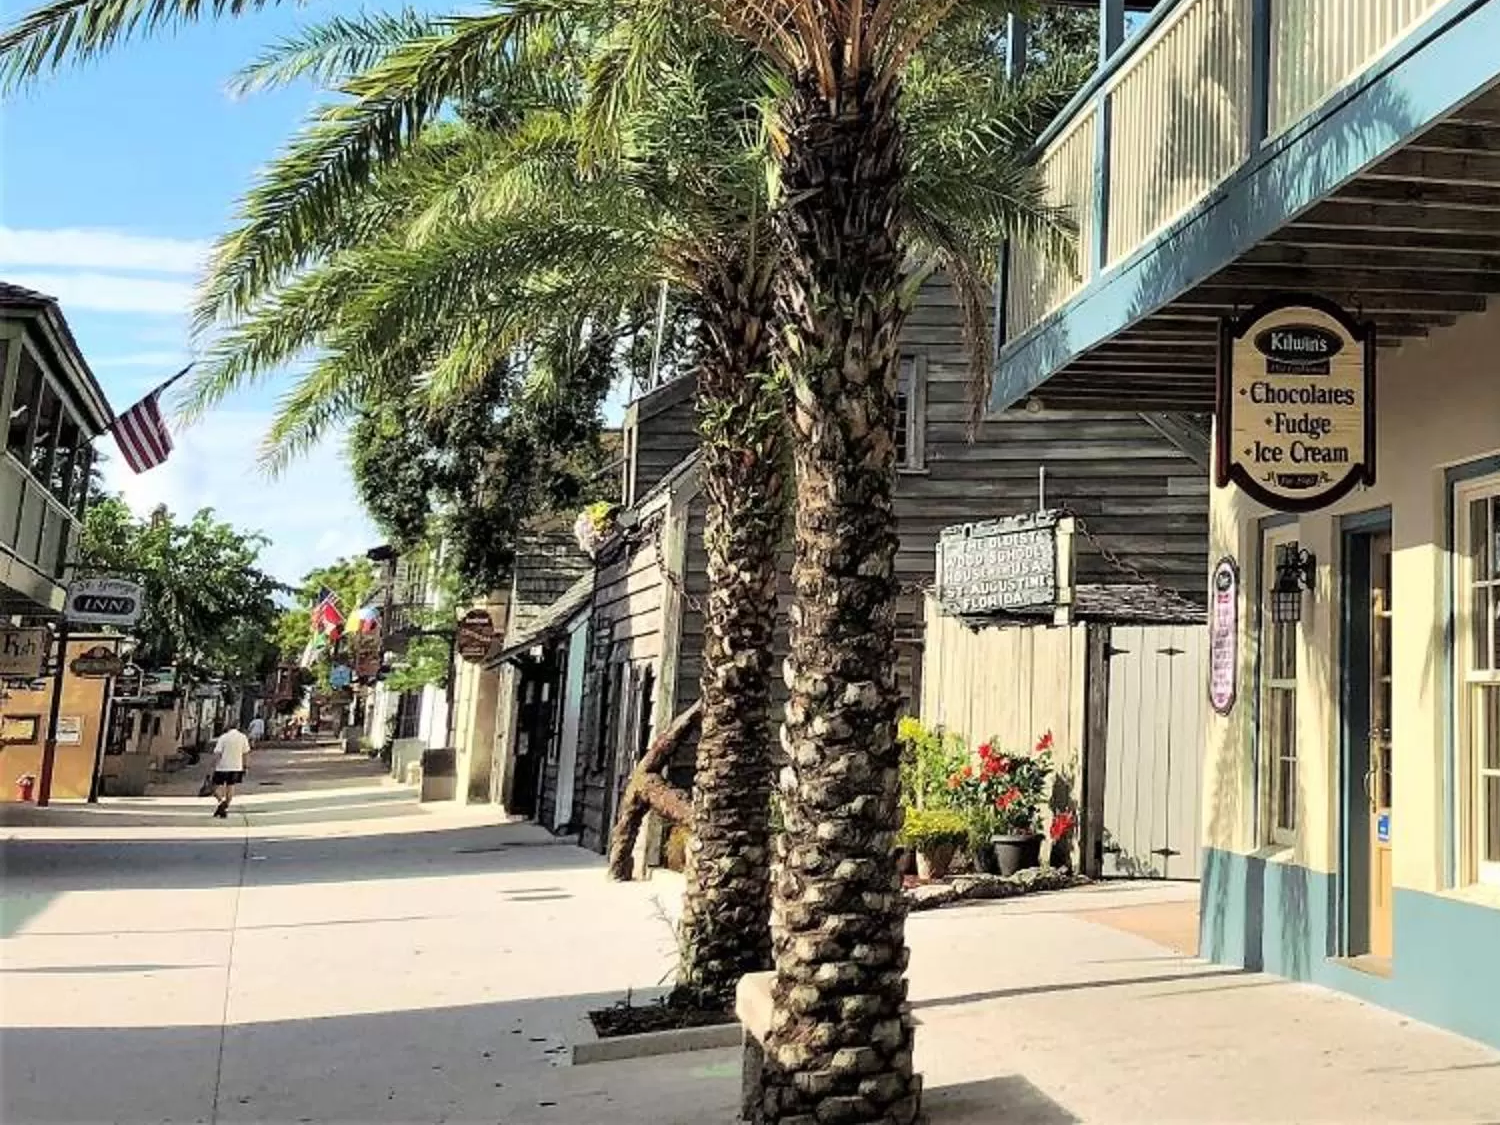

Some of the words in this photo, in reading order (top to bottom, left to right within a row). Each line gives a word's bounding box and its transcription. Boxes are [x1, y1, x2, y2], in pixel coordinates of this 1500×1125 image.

[1271, 332, 1328, 352] Kilwin's
[1251, 382, 1355, 405] Chocolates
[1275, 412, 1331, 439] Fudge
[1254, 441, 1283, 463] Ice
[1290, 442, 1349, 464] Cream
[990, 532, 1038, 548] OLDEST
[970, 574, 1047, 594] AUGUSTINE
[84, 598, 123, 612] INN
[963, 592, 1023, 610] FLORIDA
